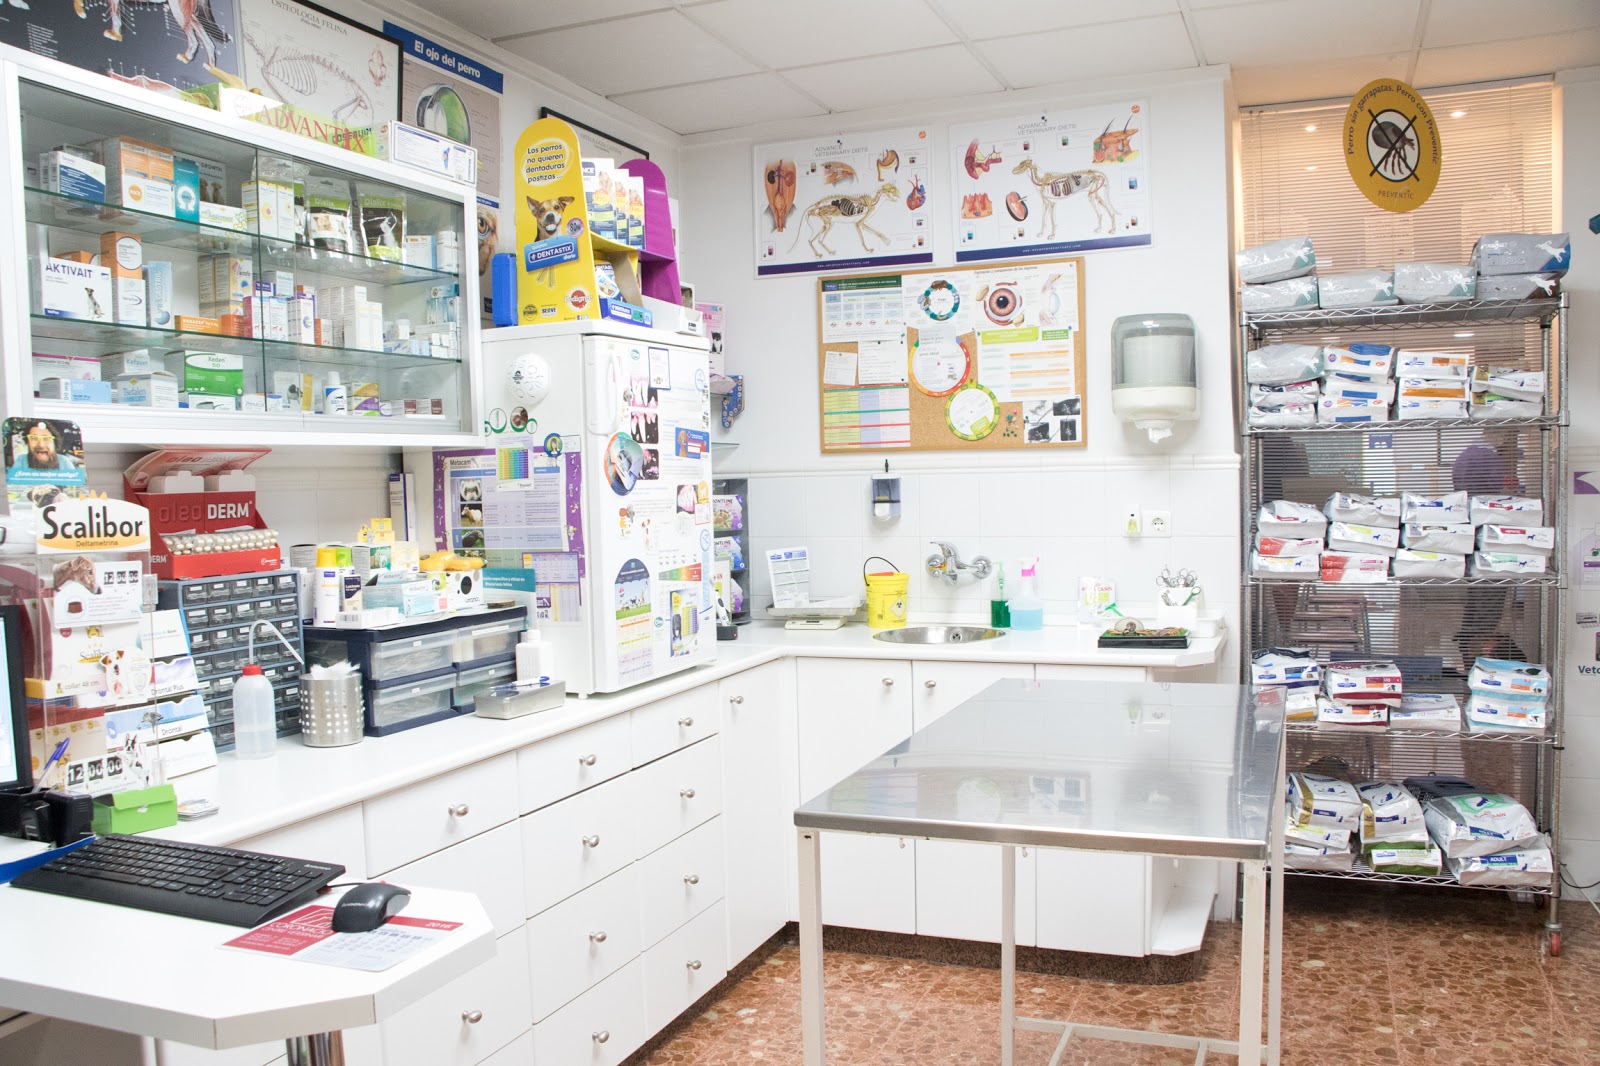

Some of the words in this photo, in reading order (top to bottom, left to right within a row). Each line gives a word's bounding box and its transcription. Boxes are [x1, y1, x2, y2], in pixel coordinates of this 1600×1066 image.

[271, 0, 320, 24] OSTEOLOGIA
[321, 20, 348, 36] FELINA
[414, 39, 424, 52] El
[425, 46, 440, 65] ojo
[441, 50, 456, 68] del
[457, 61, 481, 79] perro
[1017, 122, 1048, 130] ADVANCE
[1017, 126, 1056, 136] VETERINARY
[1058, 123, 1077, 131] DIETS
[1350, 111, 1359, 124] sin
[1357, 85, 1394, 112] garrapatas.
[1396, 85, 1416, 103] Perro
[1416, 102, 1428, 119] con
[1426, 119, 1440, 164] Preventic
[527, 147, 539, 155] Los
[541, 143, 563, 153] perros
[815, 144, 843, 152] ADVANCE
[815, 149, 850, 158] VETERINARY
[537, 153, 564, 163] quieren
[200, 162, 223, 173] GROWTH
[526, 163, 565, 174] dentaduras
[314, 197, 335, 207] Dialix
[364, 197, 386, 206] Dialix
[537, 245, 572, 259] DENTASTIX
[45, 263, 93, 279] AKTIVAIT
[126, 357, 149, 367] Kefavet
[207, 355, 226, 364] Xeden
[122, 386, 146, 397] Tsefalen
[159, 502, 201, 523] oleo
[207, 502, 249, 520] DERM
[43, 505, 143, 540] Scalibor
[76, 538, 119, 548] Deltametrina
[80, 648, 108, 661] Scalibo
[64, 682, 81, 691] collar
[151, 685, 172, 695] Drontal
[161, 725, 183, 736] Drontal
[68, 766, 84, 785] 12
